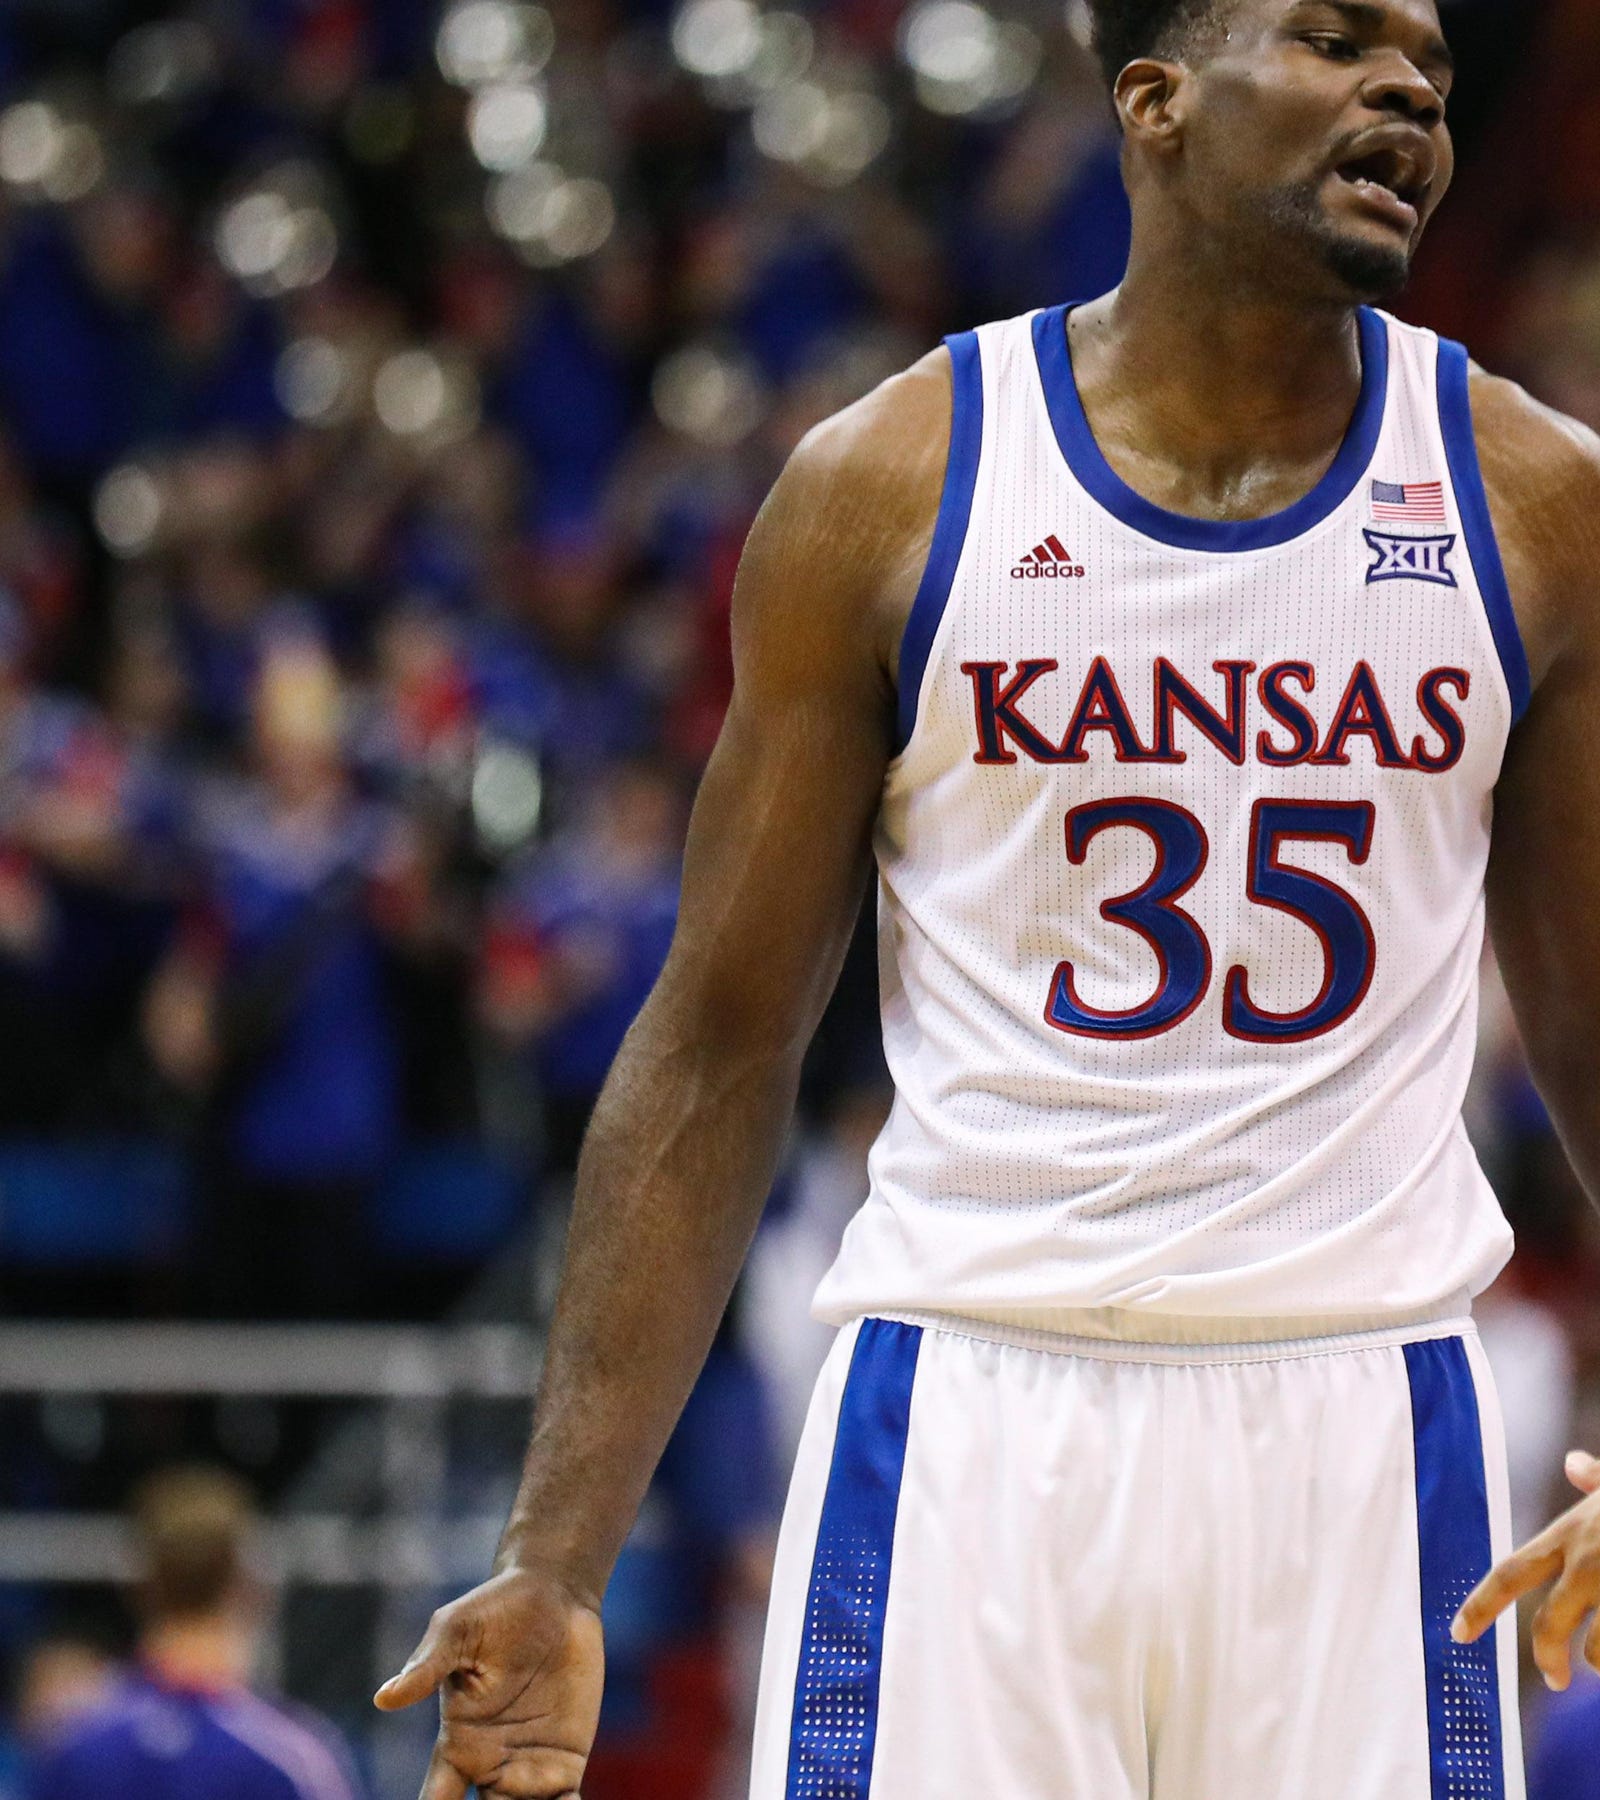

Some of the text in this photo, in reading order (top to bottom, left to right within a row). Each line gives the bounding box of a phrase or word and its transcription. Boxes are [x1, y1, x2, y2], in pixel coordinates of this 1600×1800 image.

[1010, 562, 1086, 579] adidas
[1368, 534, 1452, 581] XII
[960, 655, 1470, 774] KANSAS
[1044, 796, 1376, 1044] 35
